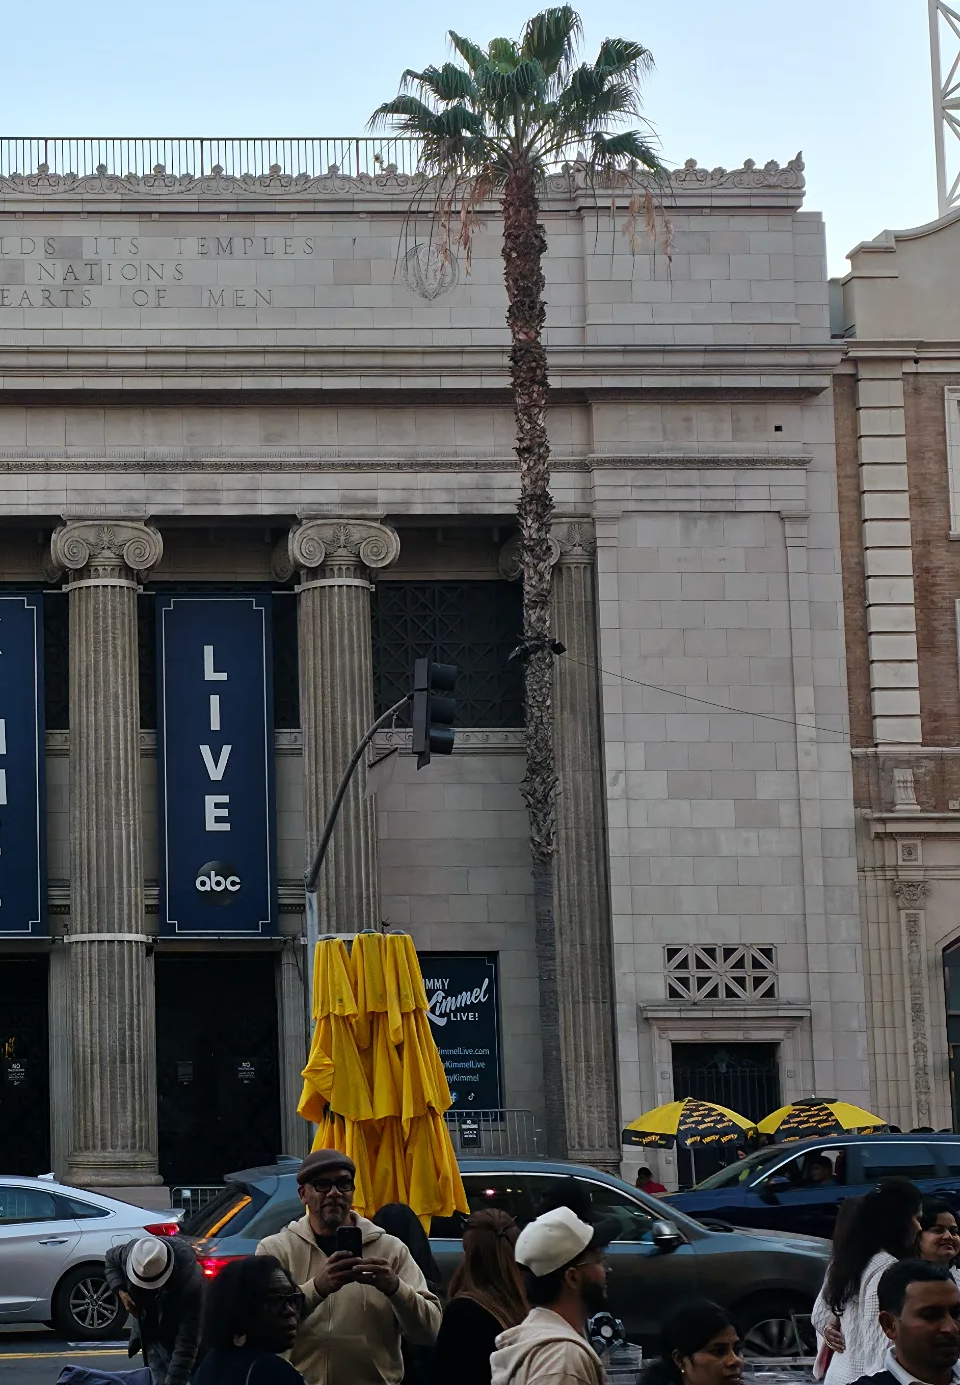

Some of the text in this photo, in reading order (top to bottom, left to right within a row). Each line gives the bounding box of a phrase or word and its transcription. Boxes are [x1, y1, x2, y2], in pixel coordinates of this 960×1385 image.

[93, 237, 139, 255] ITS
[173, 237, 314, 255] TEMPLES
[37, 263, 184, 281] NATIONS
[132, 289, 167, 307] OF
[208, 289, 273, 307] MEN
[199, 645, 233, 831] LIVE
[195, 870, 241, 892] abc
[422, 978, 450, 990] IMMY
[450, 1012, 479, 1021] LIVE!
